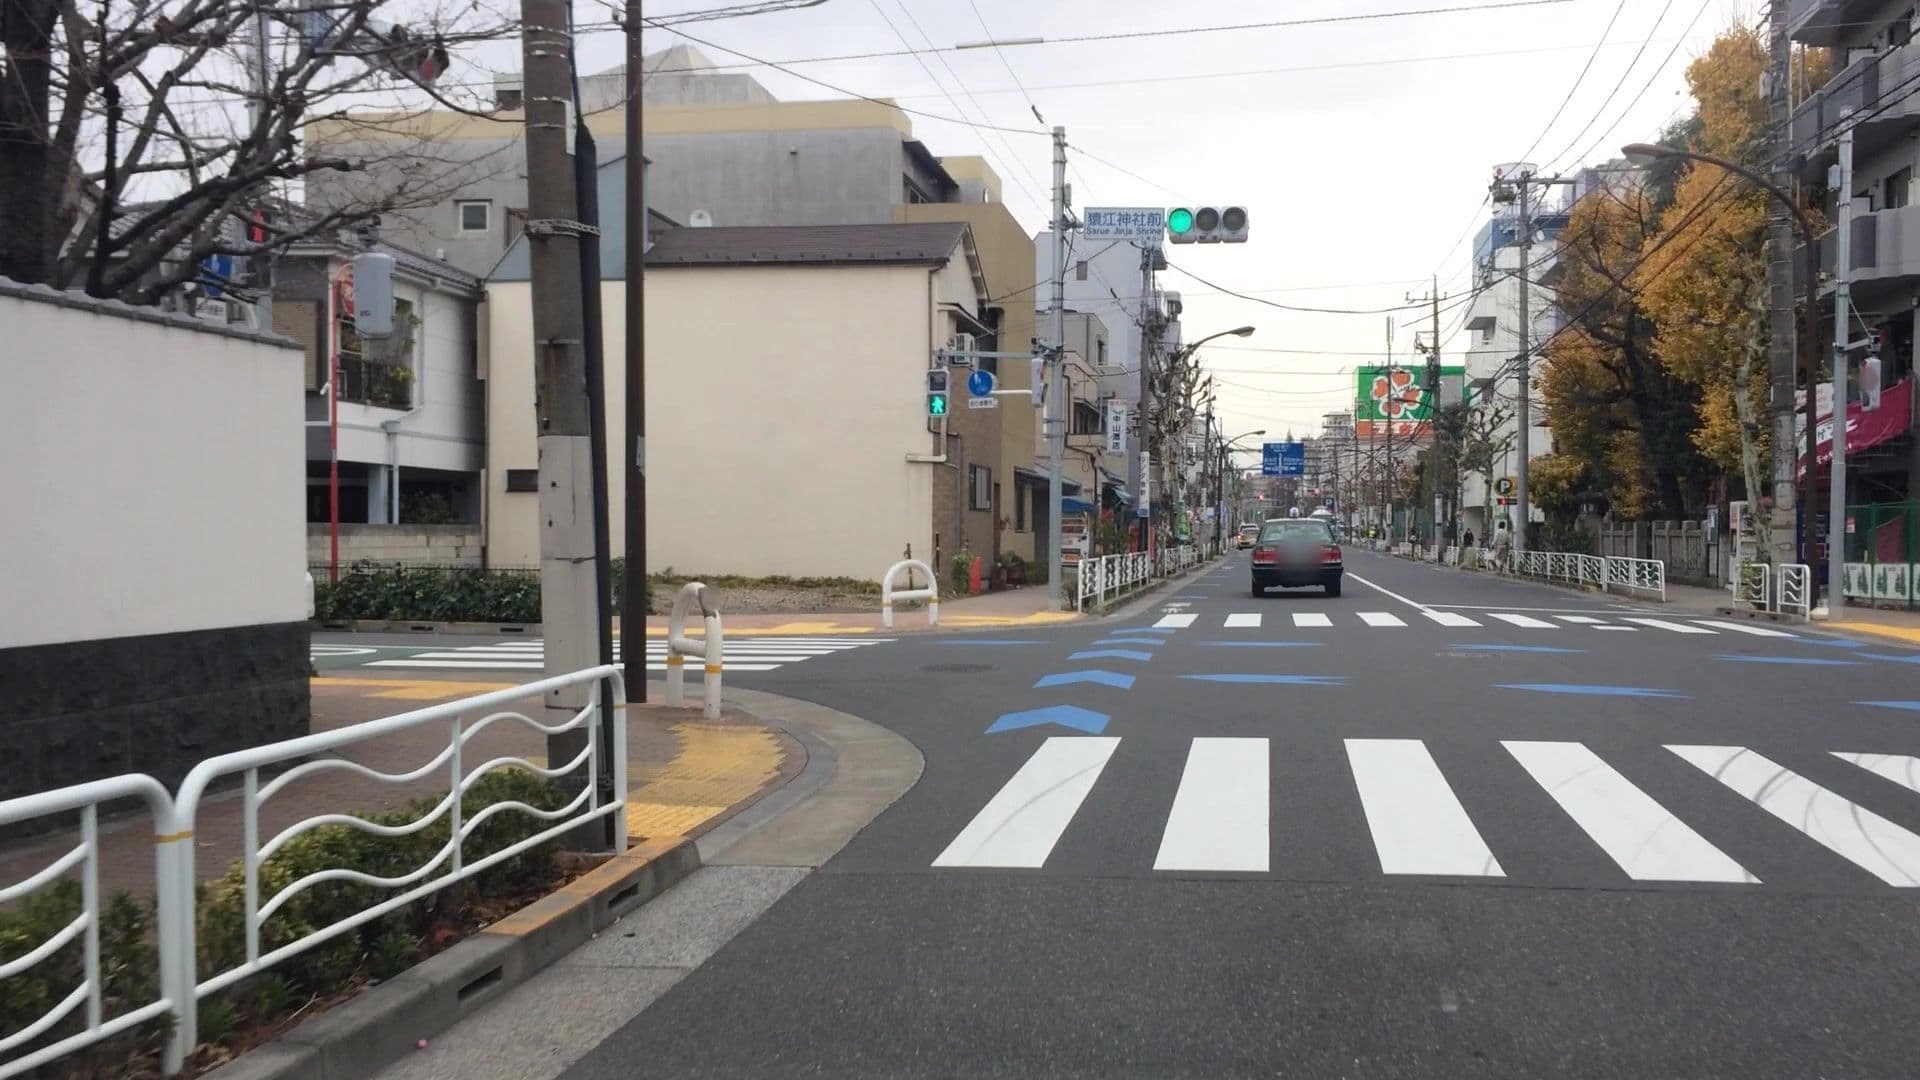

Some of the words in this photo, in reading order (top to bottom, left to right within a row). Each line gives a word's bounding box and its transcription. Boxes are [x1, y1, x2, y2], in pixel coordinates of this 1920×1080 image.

[1087, 212, 1162, 226] 猿江神社前
[1086, 227, 1110, 235] Sarue
[1113, 227, 1133, 236] Jinja
[1136, 227, 1162, 235] Shrine
[1112, 415, 1121, 450] 中山酒店
[1500, 480, 1511, 493] P
